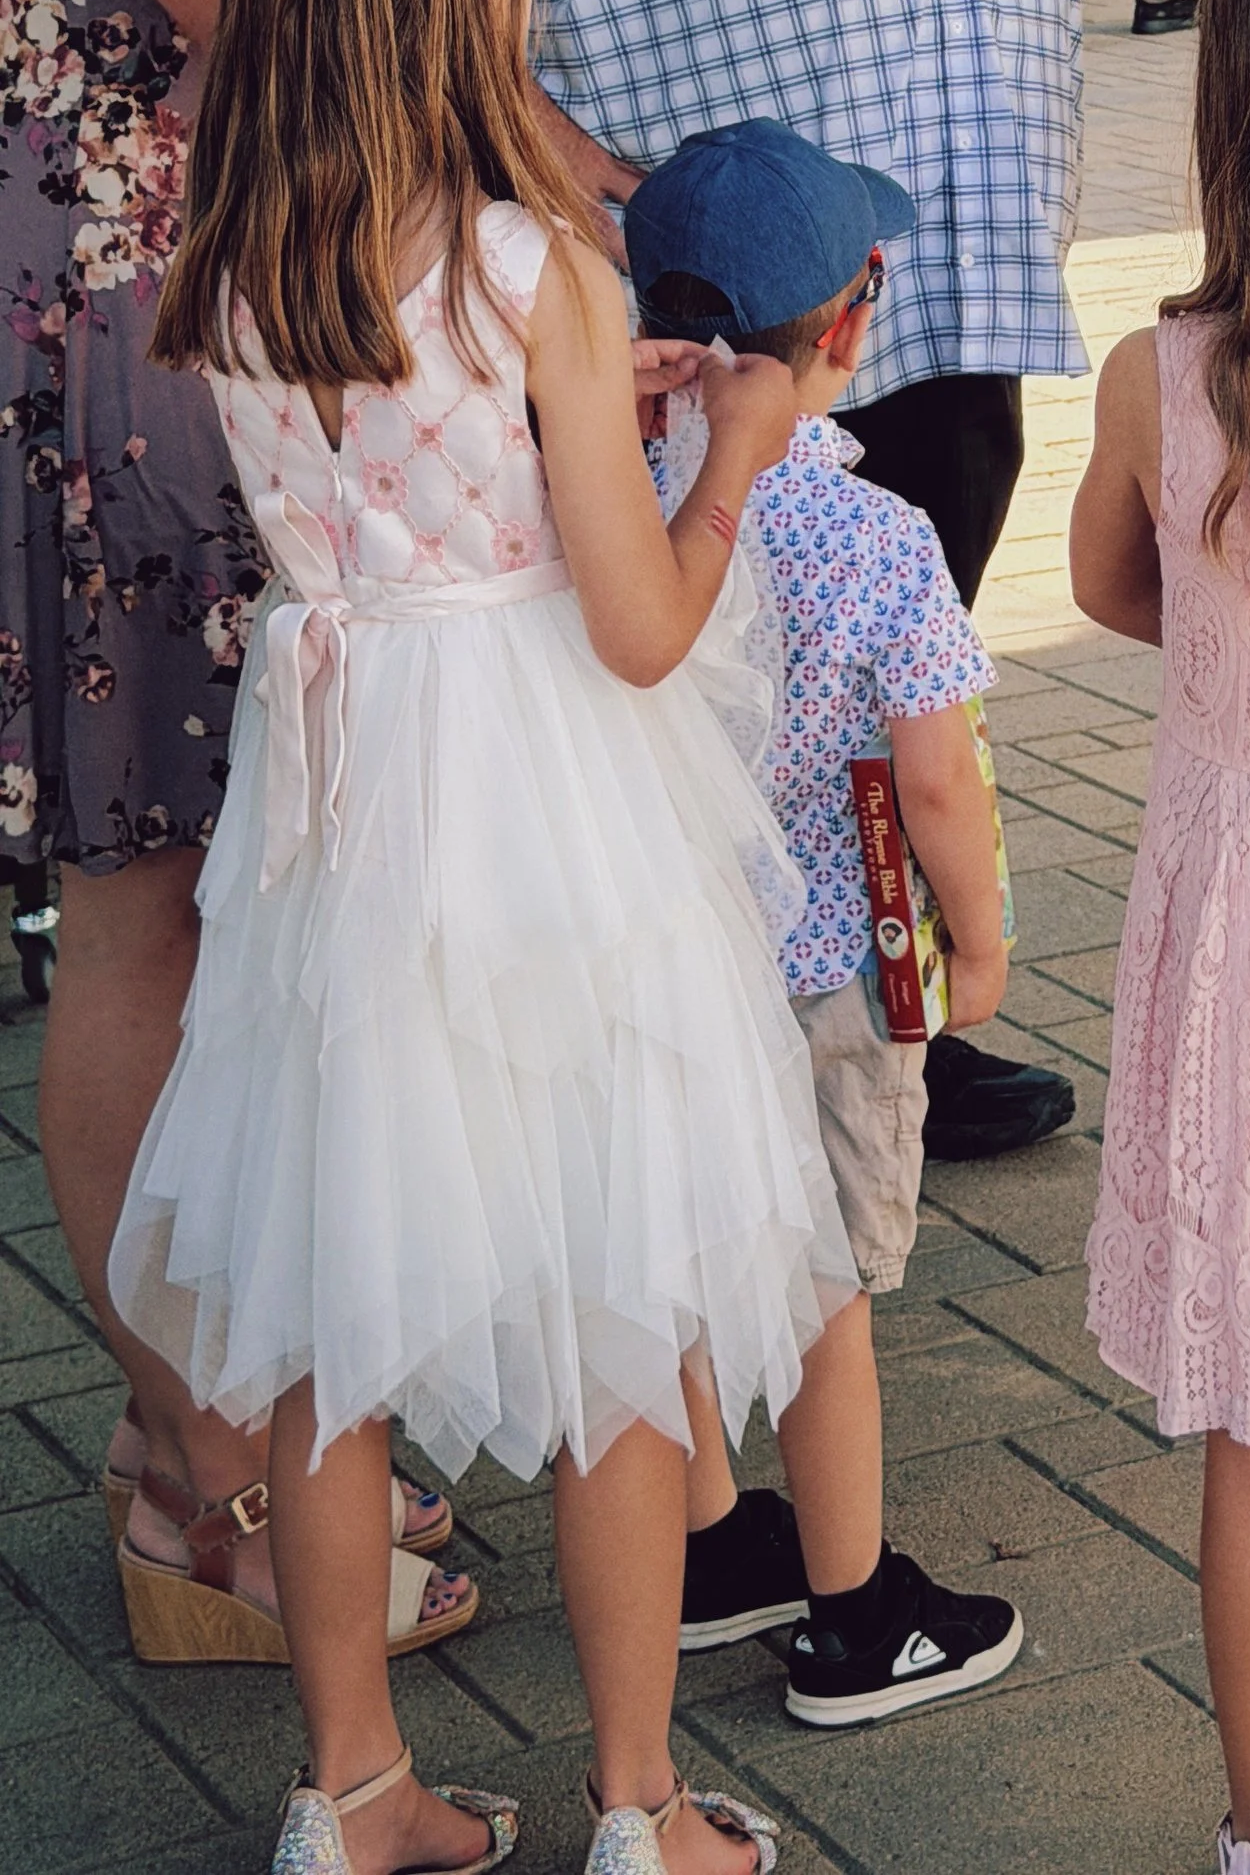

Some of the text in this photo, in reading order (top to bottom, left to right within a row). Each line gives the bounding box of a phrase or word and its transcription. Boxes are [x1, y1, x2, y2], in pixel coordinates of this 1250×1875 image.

[868, 781, 897, 905] The Rhyme Bible
